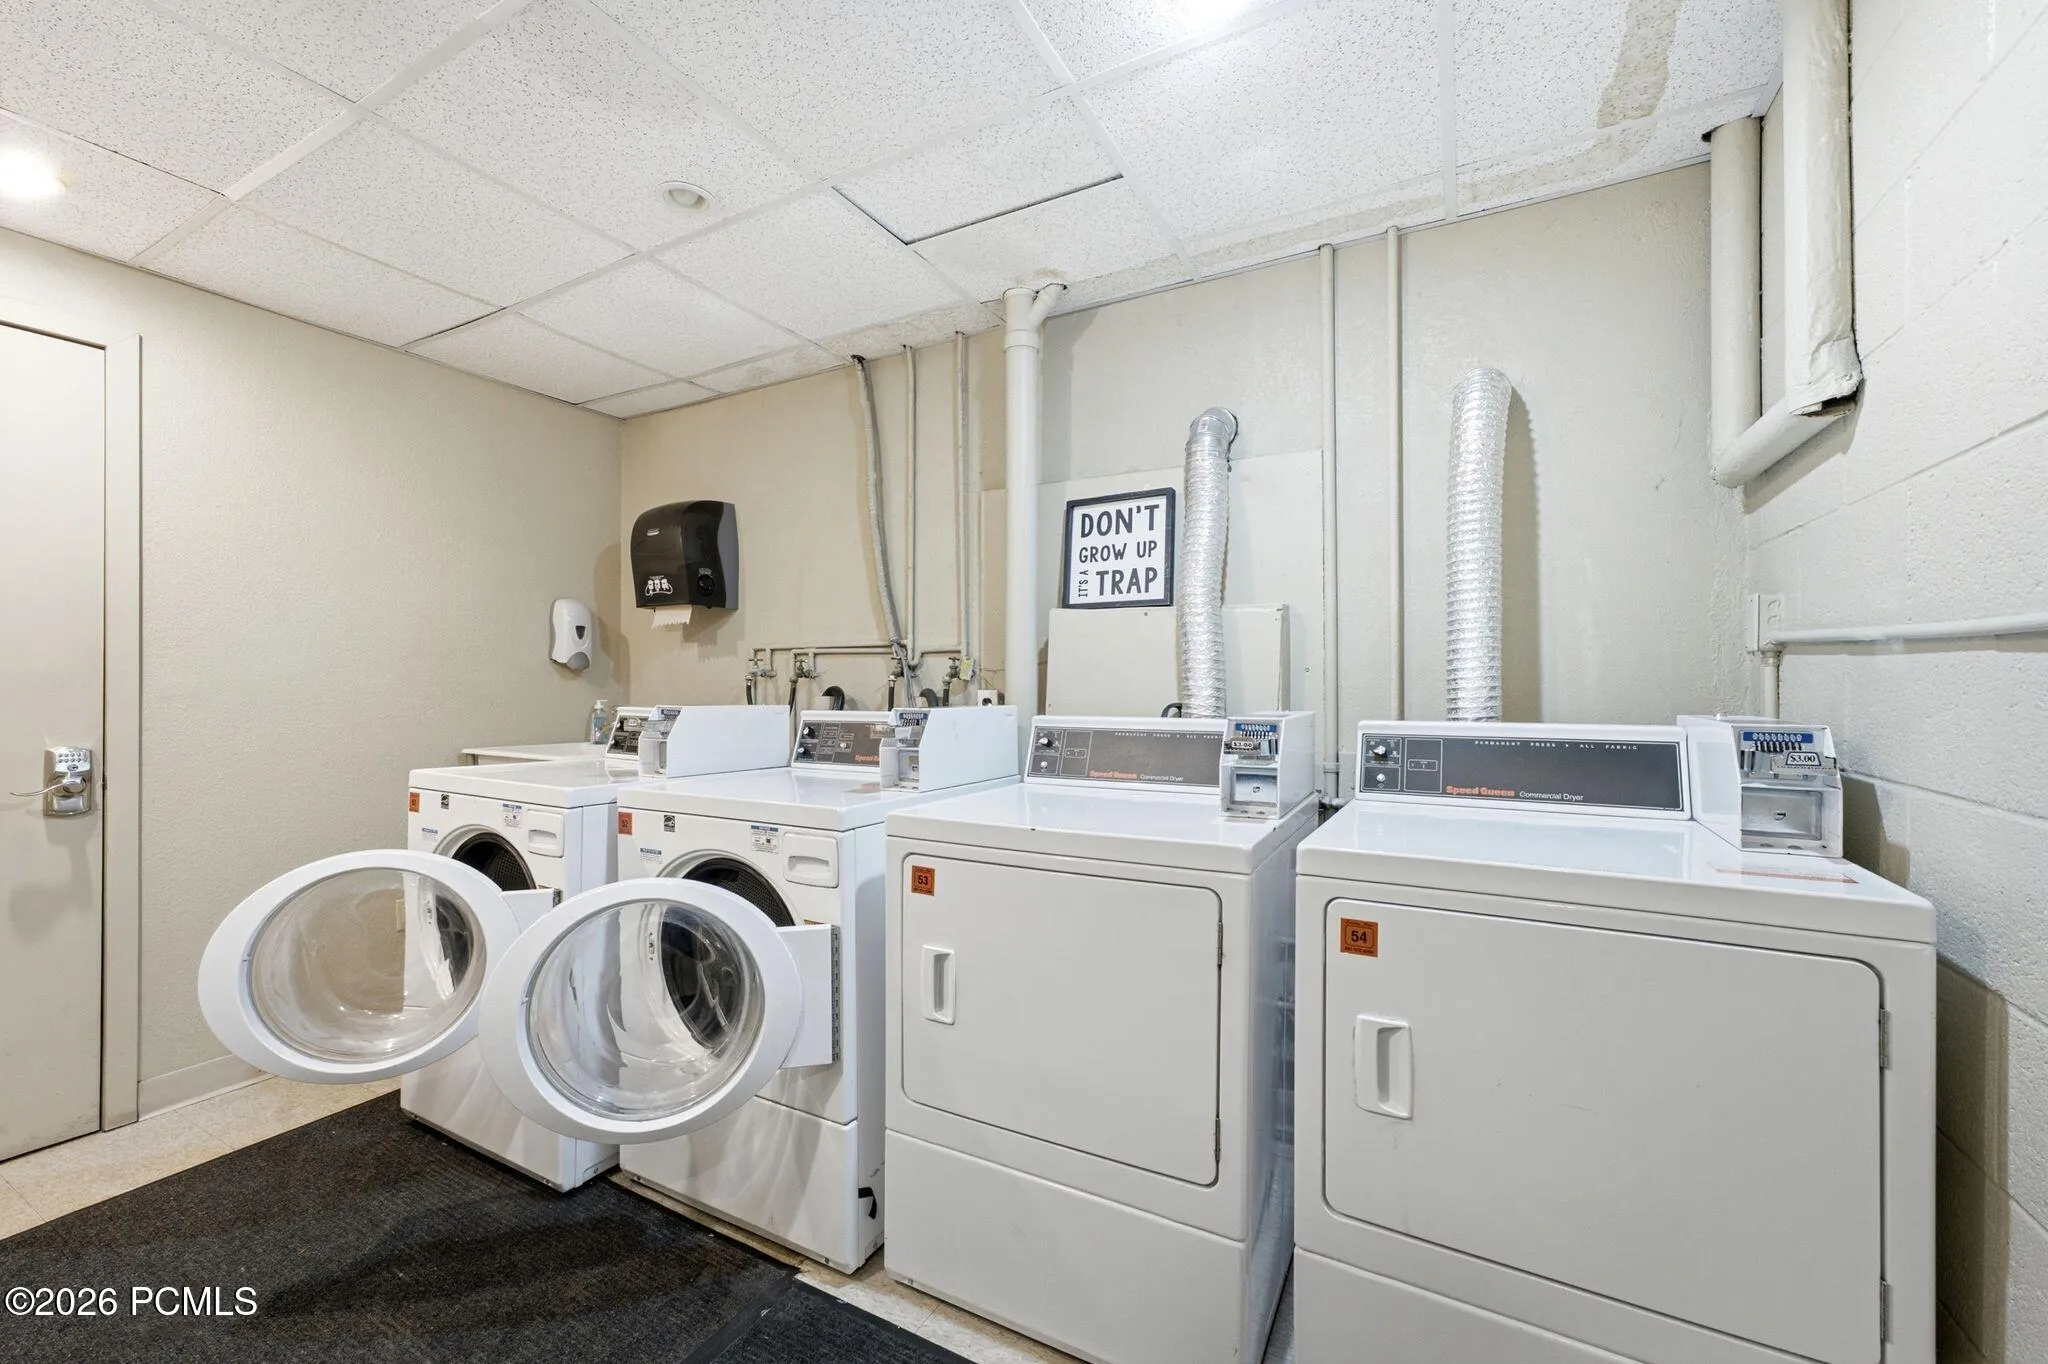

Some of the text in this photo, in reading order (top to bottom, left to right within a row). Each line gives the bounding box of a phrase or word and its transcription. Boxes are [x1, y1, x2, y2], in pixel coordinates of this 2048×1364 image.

[1081, 504, 1159, 538] DON'T
[1079, 540, 1157, 563] GROW UP
[1078, 579, 1089, 597] IT'S
[1095, 567, 1158, 596] TRAP
[1790, 754, 1816, 763] $3.00
[1446, 786, 1584, 802] Speed Queen Commercial Dryer
[918, 875, 928, 885] 53
[1351, 930, 1367, 944] 54
